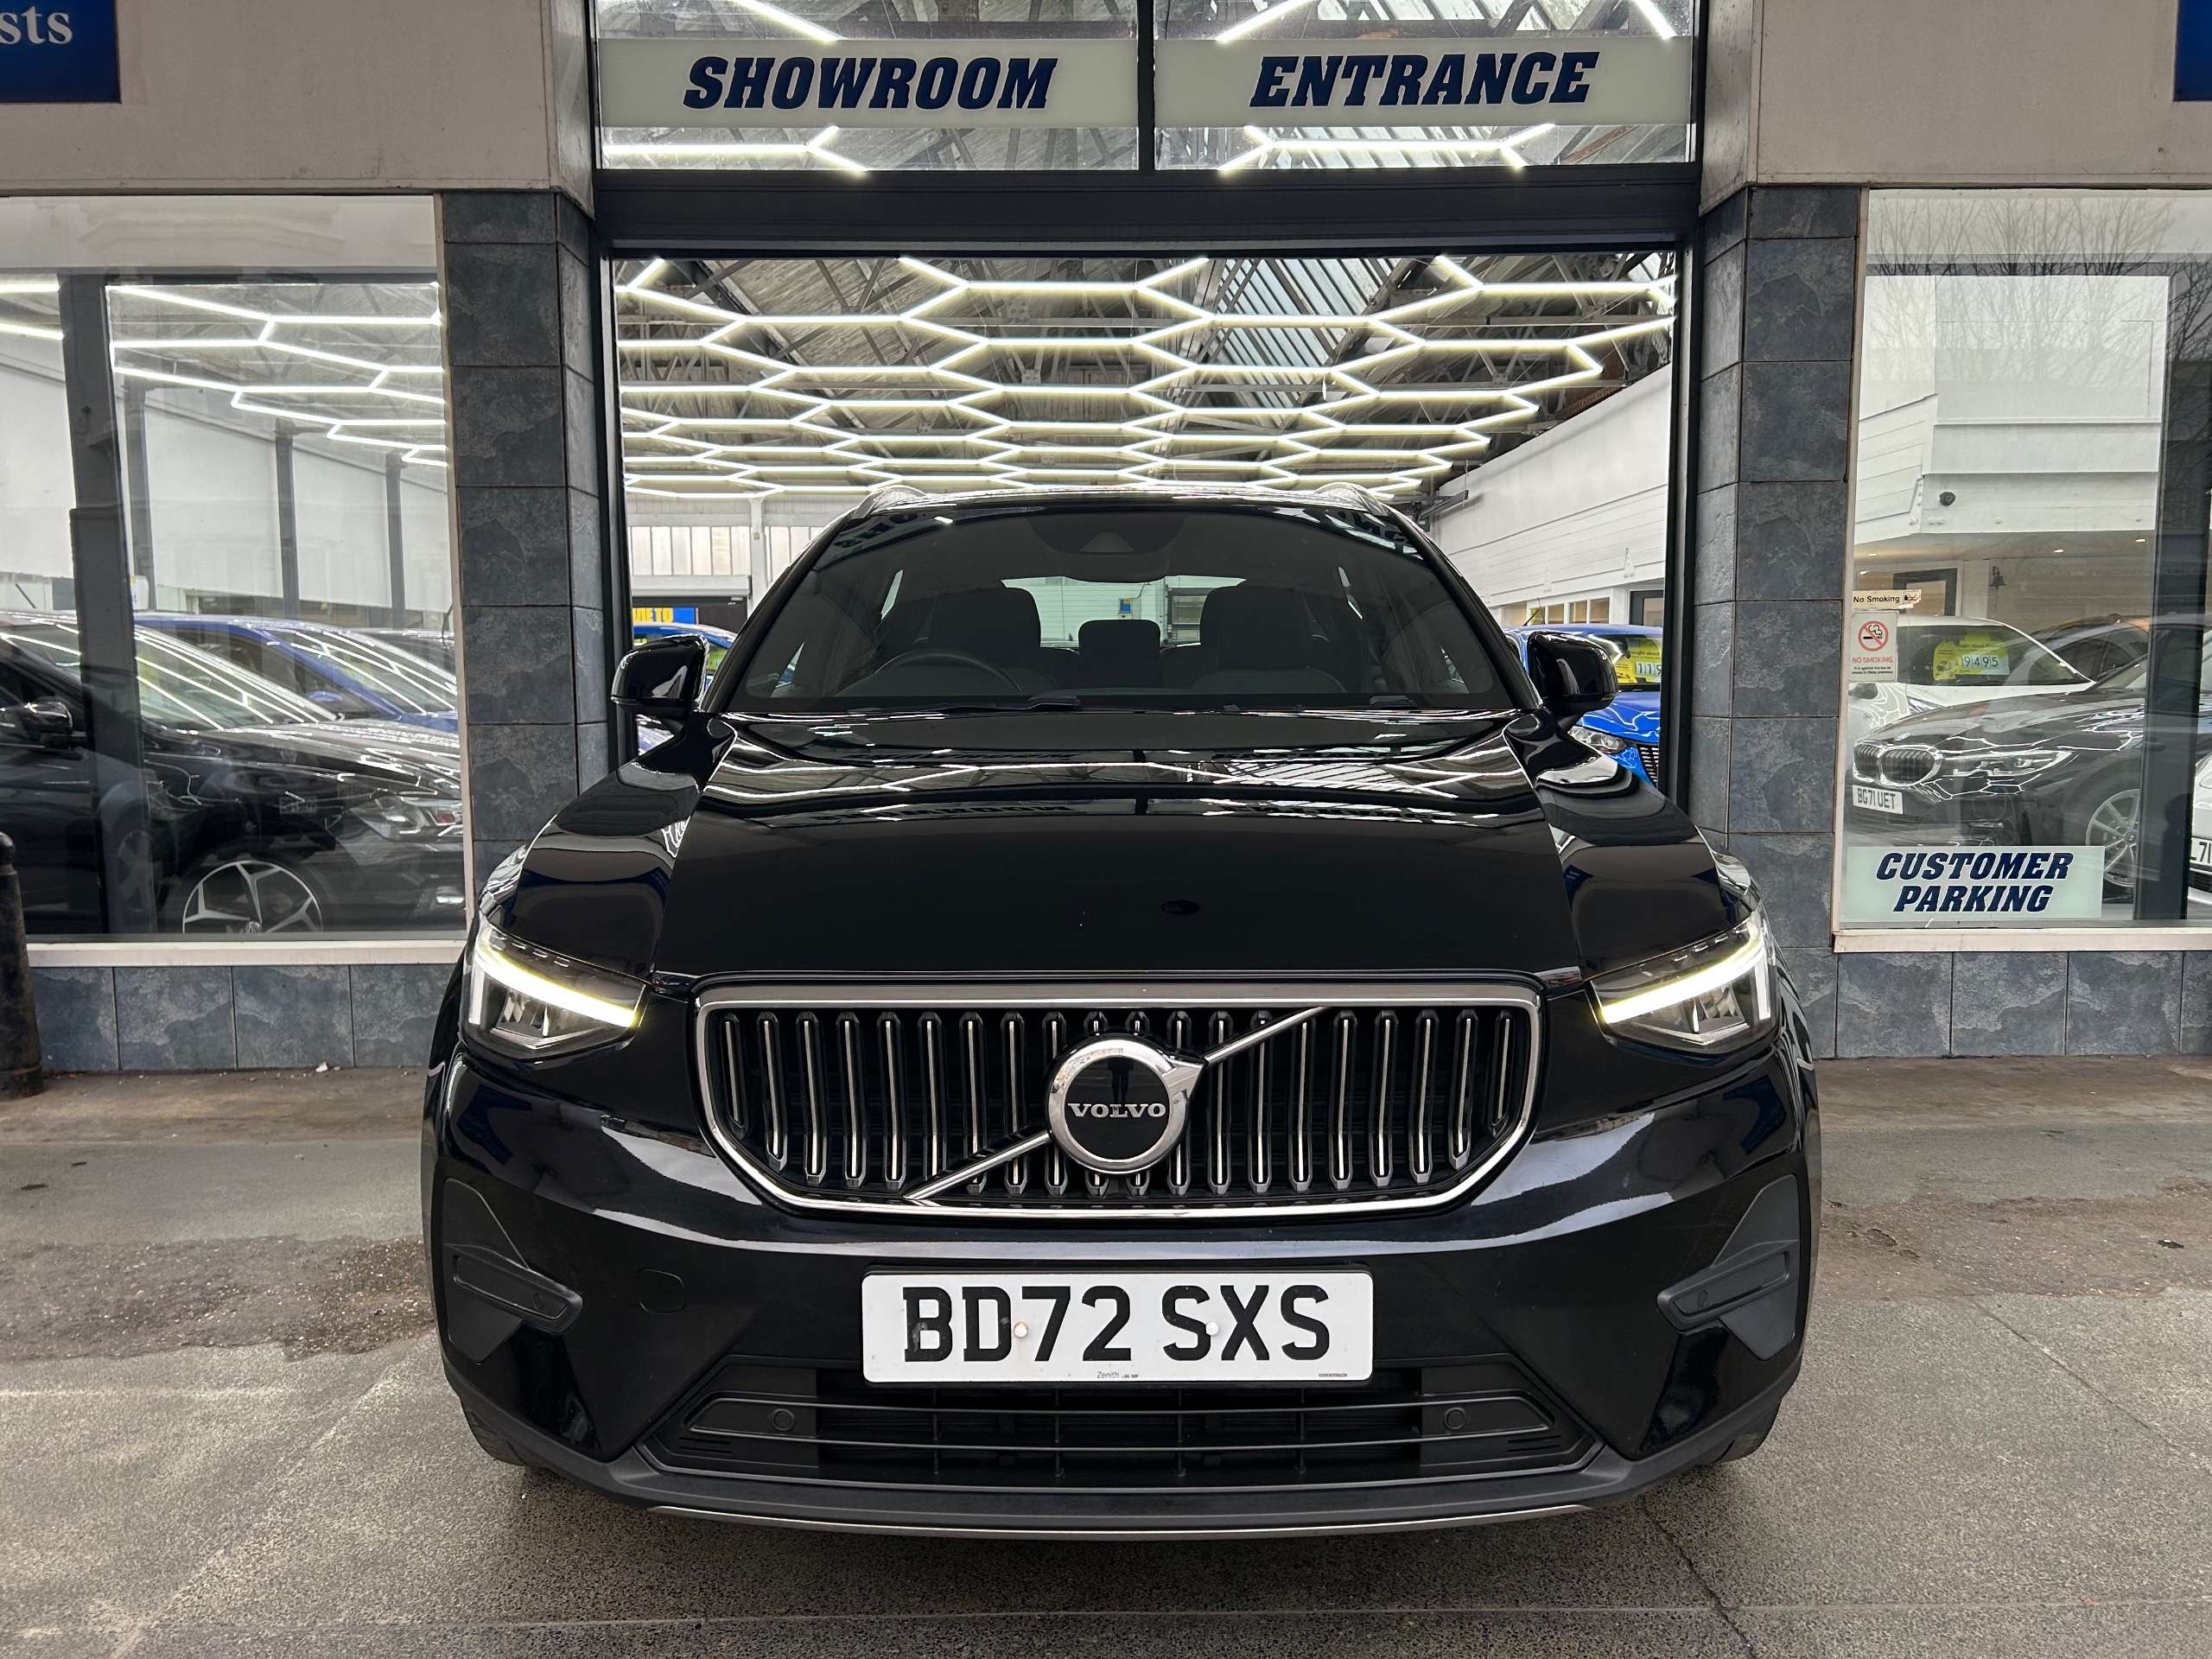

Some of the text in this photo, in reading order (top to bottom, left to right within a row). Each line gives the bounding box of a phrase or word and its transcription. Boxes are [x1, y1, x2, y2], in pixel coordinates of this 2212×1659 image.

[0, 6, 73, 44] sts
[683, 56, 1058, 110] SHOWROOM
[1249, 51, 1600, 107] ENTRANCE
[1866, 595, 1900, 604] Smoking
[1857, 788, 1896, 809] BG71 UET
[1876, 852, 2074, 880] CUSTOMER
[1893, 885, 2054, 912] PARKING
[1068, 1103, 1166, 1118] VOLVO
[902, 1285, 1330, 1362] BD72 SXS
